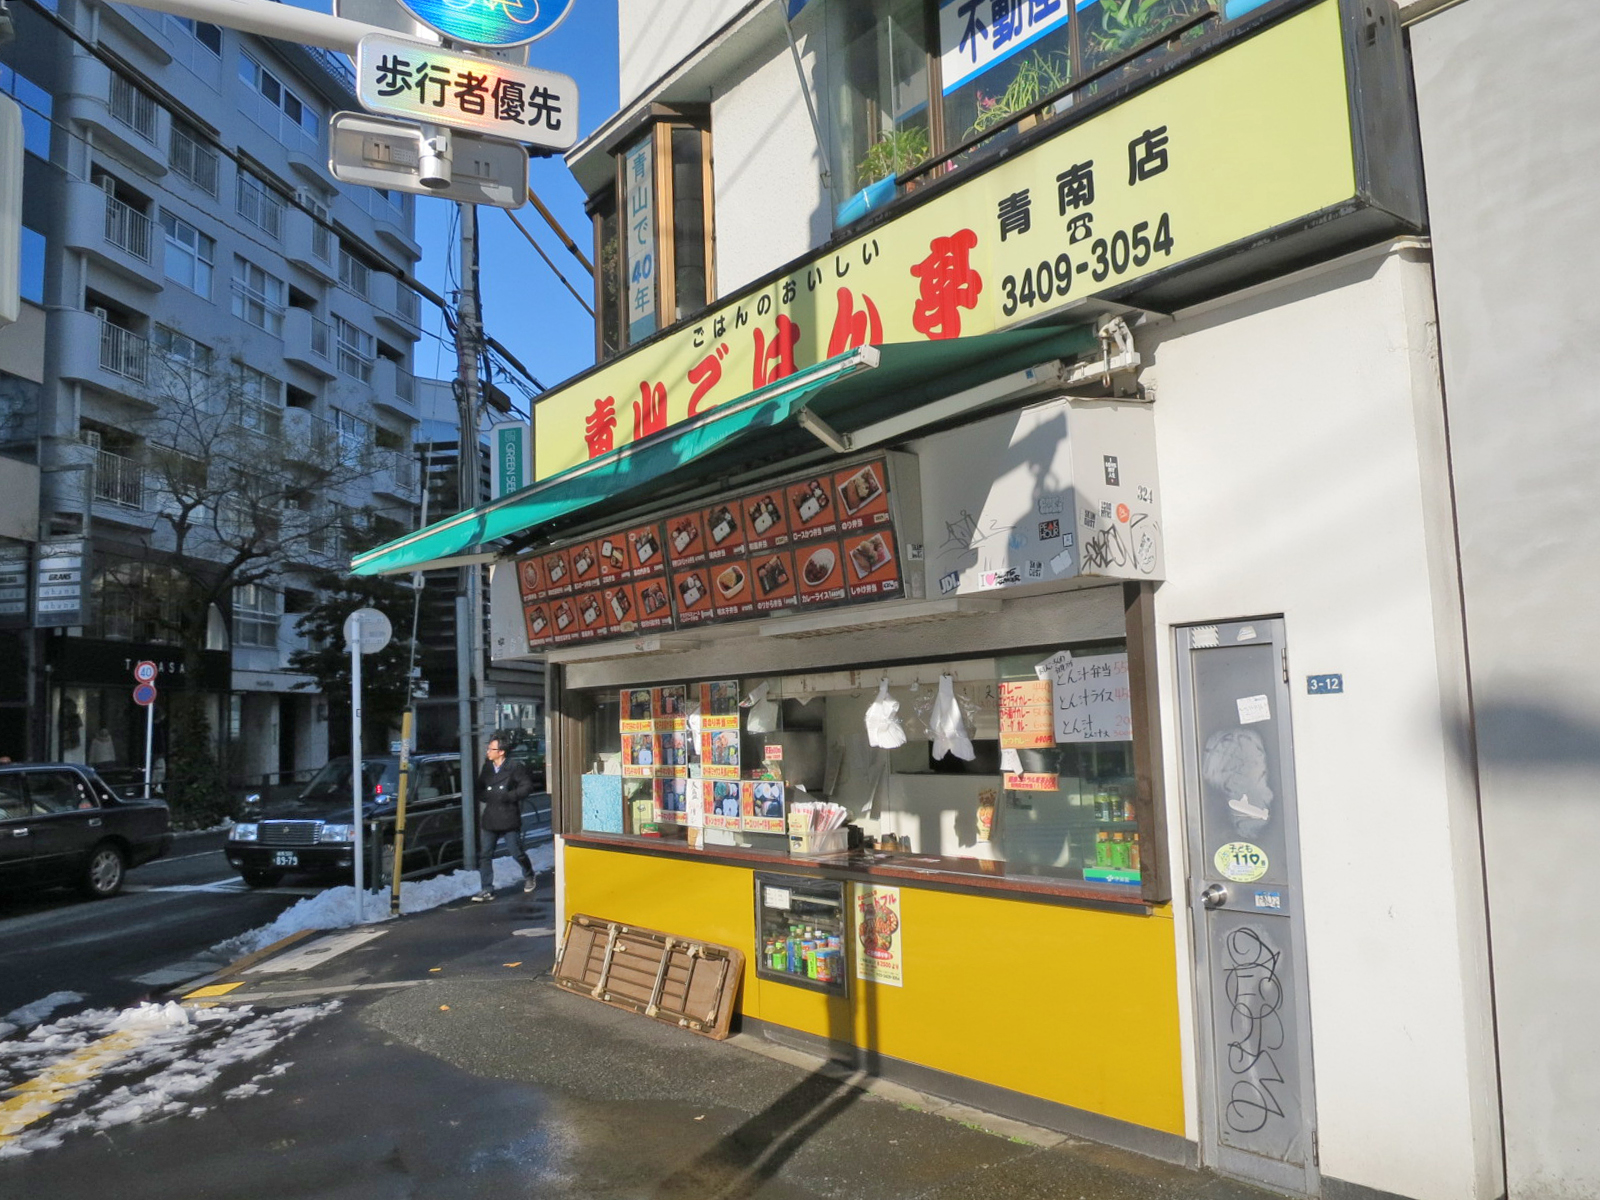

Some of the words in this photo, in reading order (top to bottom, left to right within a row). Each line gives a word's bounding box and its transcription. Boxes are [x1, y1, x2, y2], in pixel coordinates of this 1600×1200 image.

[376, 55, 562, 131] 歩行者優先
[997, 125, 1169, 242] 青南店
[632, 151, 652, 313] 青山で40年
[1001, 212, 1174, 317] 3409-3054
[693, 239, 880, 348] ごはんのおいしい
[1137, 484, 1153, 504] 324
[801, 590, 829, 604] カレーライス
[850, 584, 877, 595] しゃけ弁当
[140, 667, 152, 677] 40
[1057, 662, 1111, 686] とん汁弁当
[998, 682, 1022, 695] カレー
[1310, 678, 1339, 690] 3-12
[1060, 688, 1115, 710] とん汁ライス
[1062, 714, 1093, 735] とん汁
[276, 856, 298, 866] 89-79
